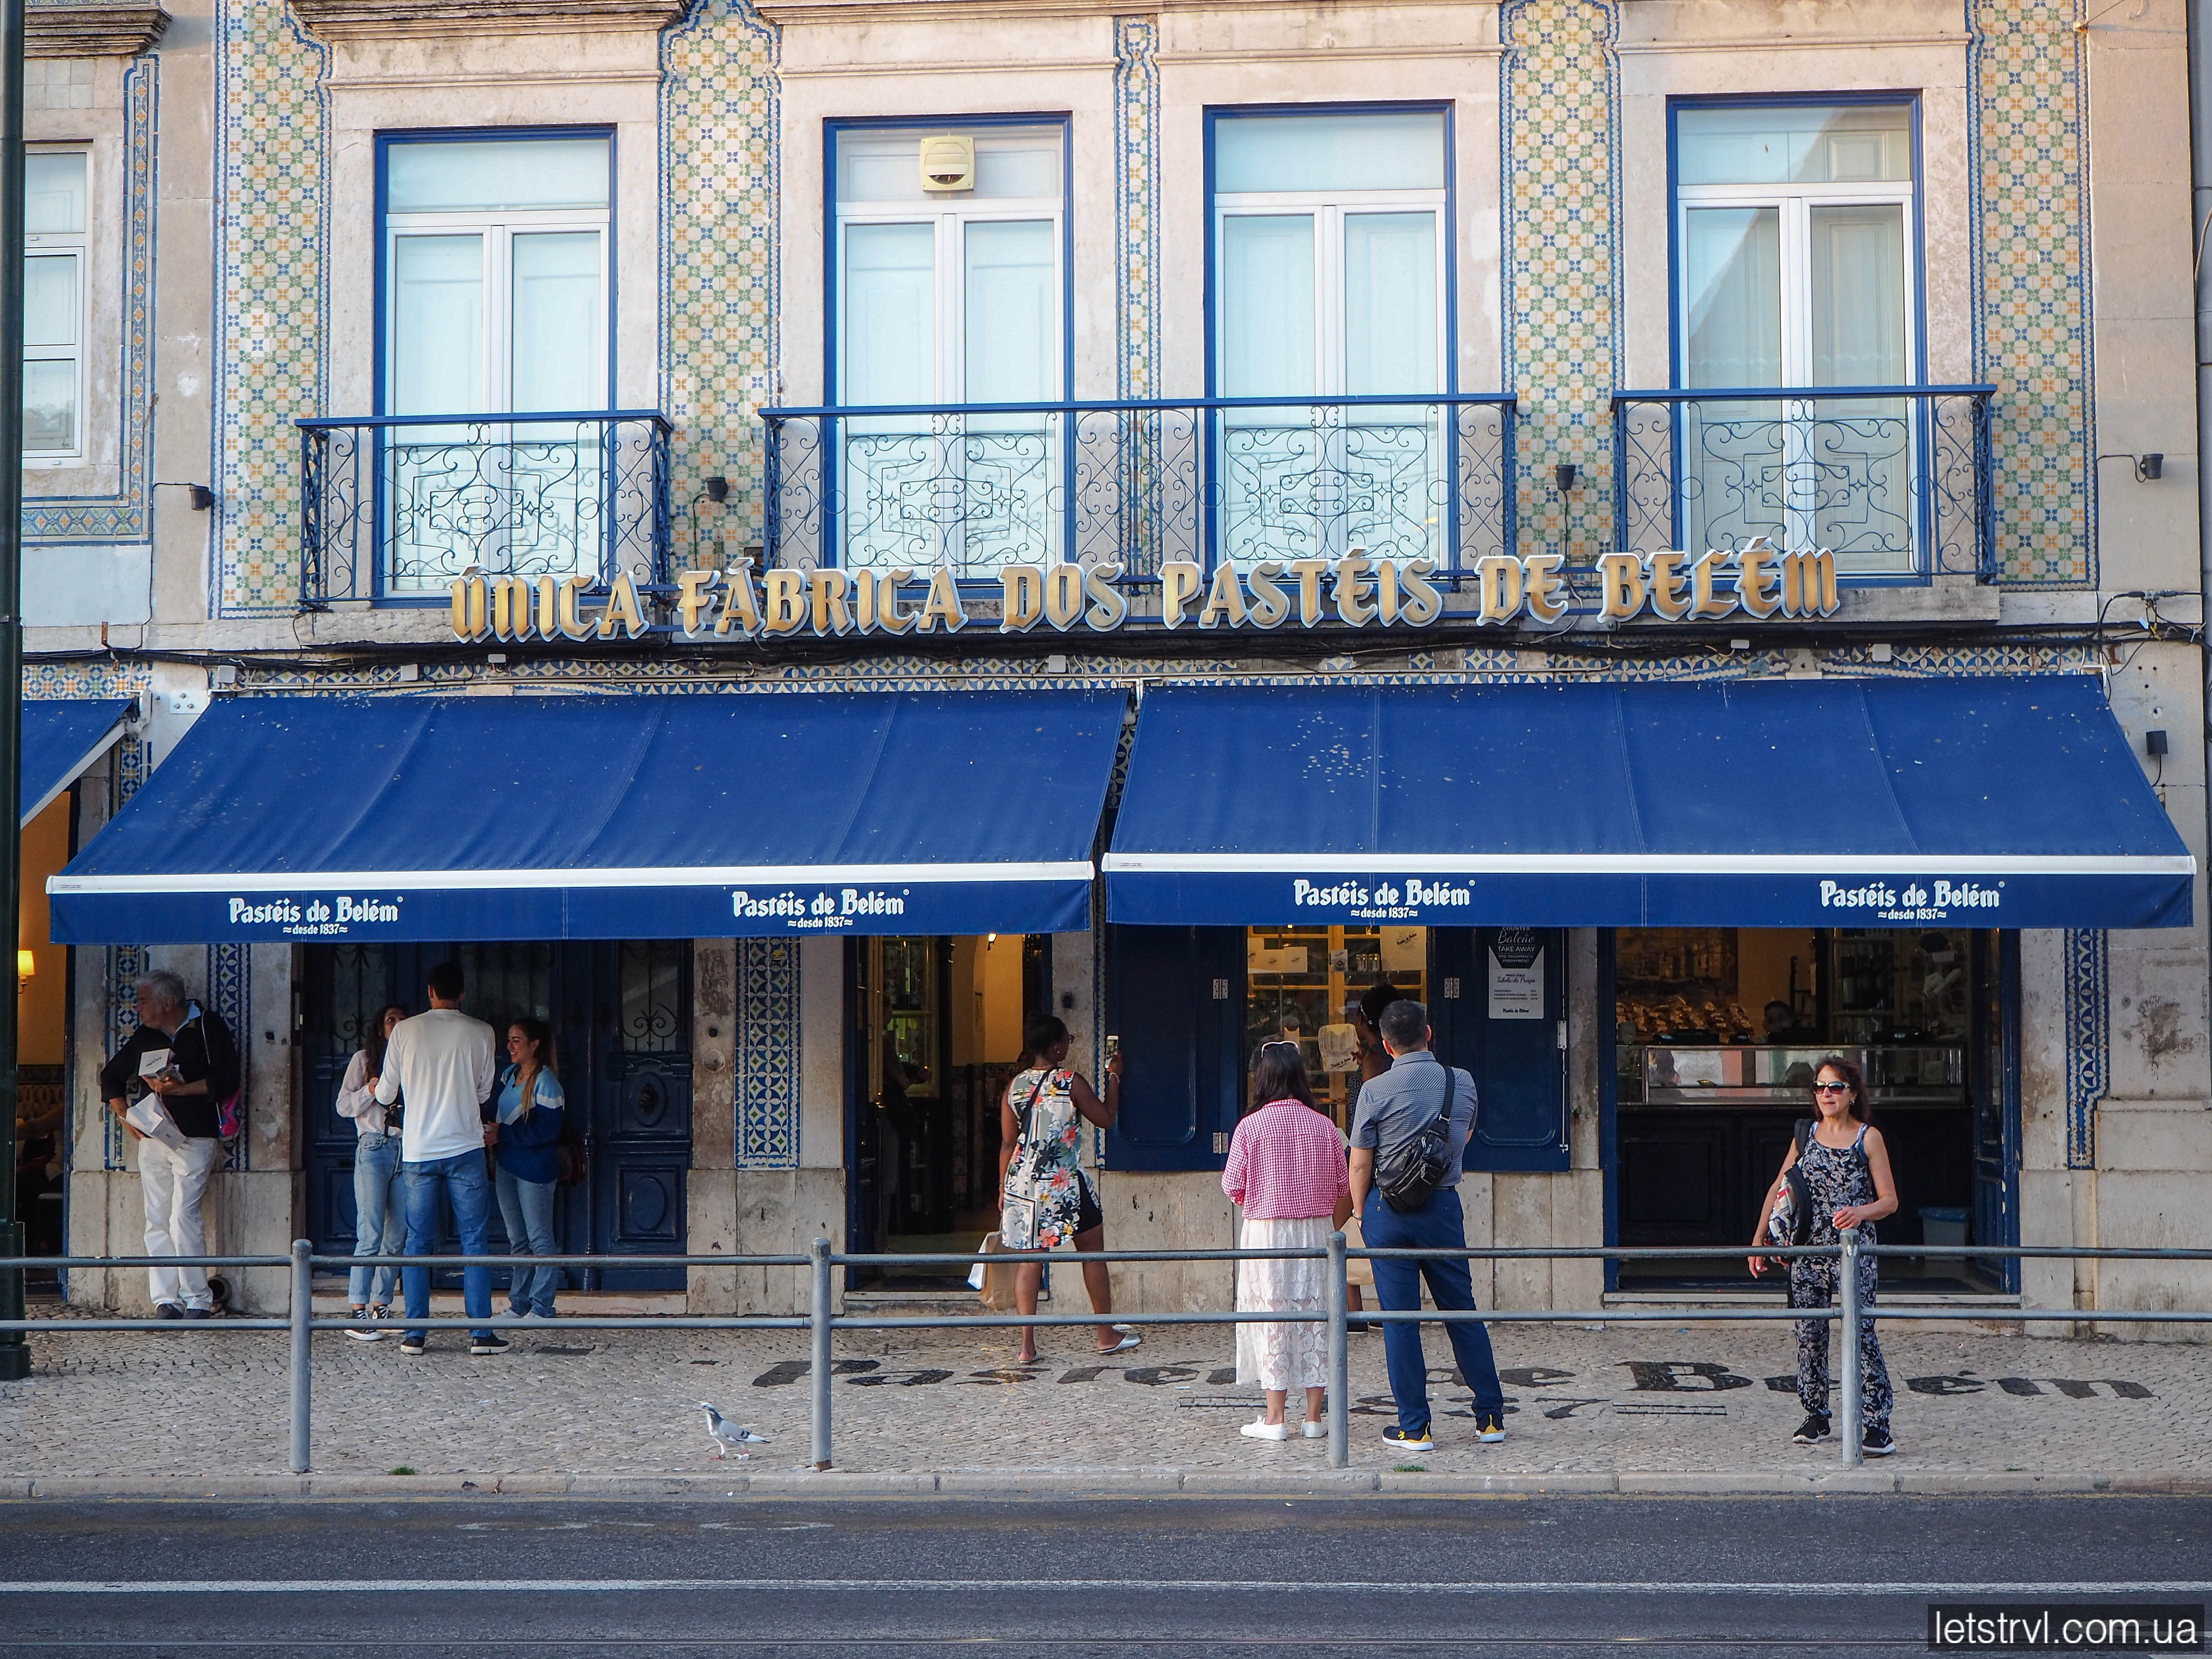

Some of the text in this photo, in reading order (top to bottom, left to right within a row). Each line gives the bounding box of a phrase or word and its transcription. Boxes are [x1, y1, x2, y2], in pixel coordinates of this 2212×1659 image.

[452, 565, 649, 642] ÚNICA
[677, 557, 968, 640] FÁBRICA
[998, 562, 1127, 633] DOS
[1157, 545, 1443, 631] PASTÉIS
[1473, 553, 1570, 626] DE
[732, 891, 805, 917] Pastéis
[811, 892, 835, 915] de
[1294, 879, 1369, 906] Pastéis
[1374, 882, 1399, 906] de
[1820, 880, 1896, 907] Pastéis
[1902, 883, 1927, 907] de
[229, 898, 301, 923] Pastéis
[306, 900, 330, 923] de
[797, 916, 845, 928] desde 1837
[1361, 907, 1409, 918] desde 1837
[1888, 908, 1938, 920] desde 1837
[293, 924, 339, 935] desde 1837
[1498, 931, 1535, 944] Balcão
[1614, 1361, 2161, 1400] Beém
